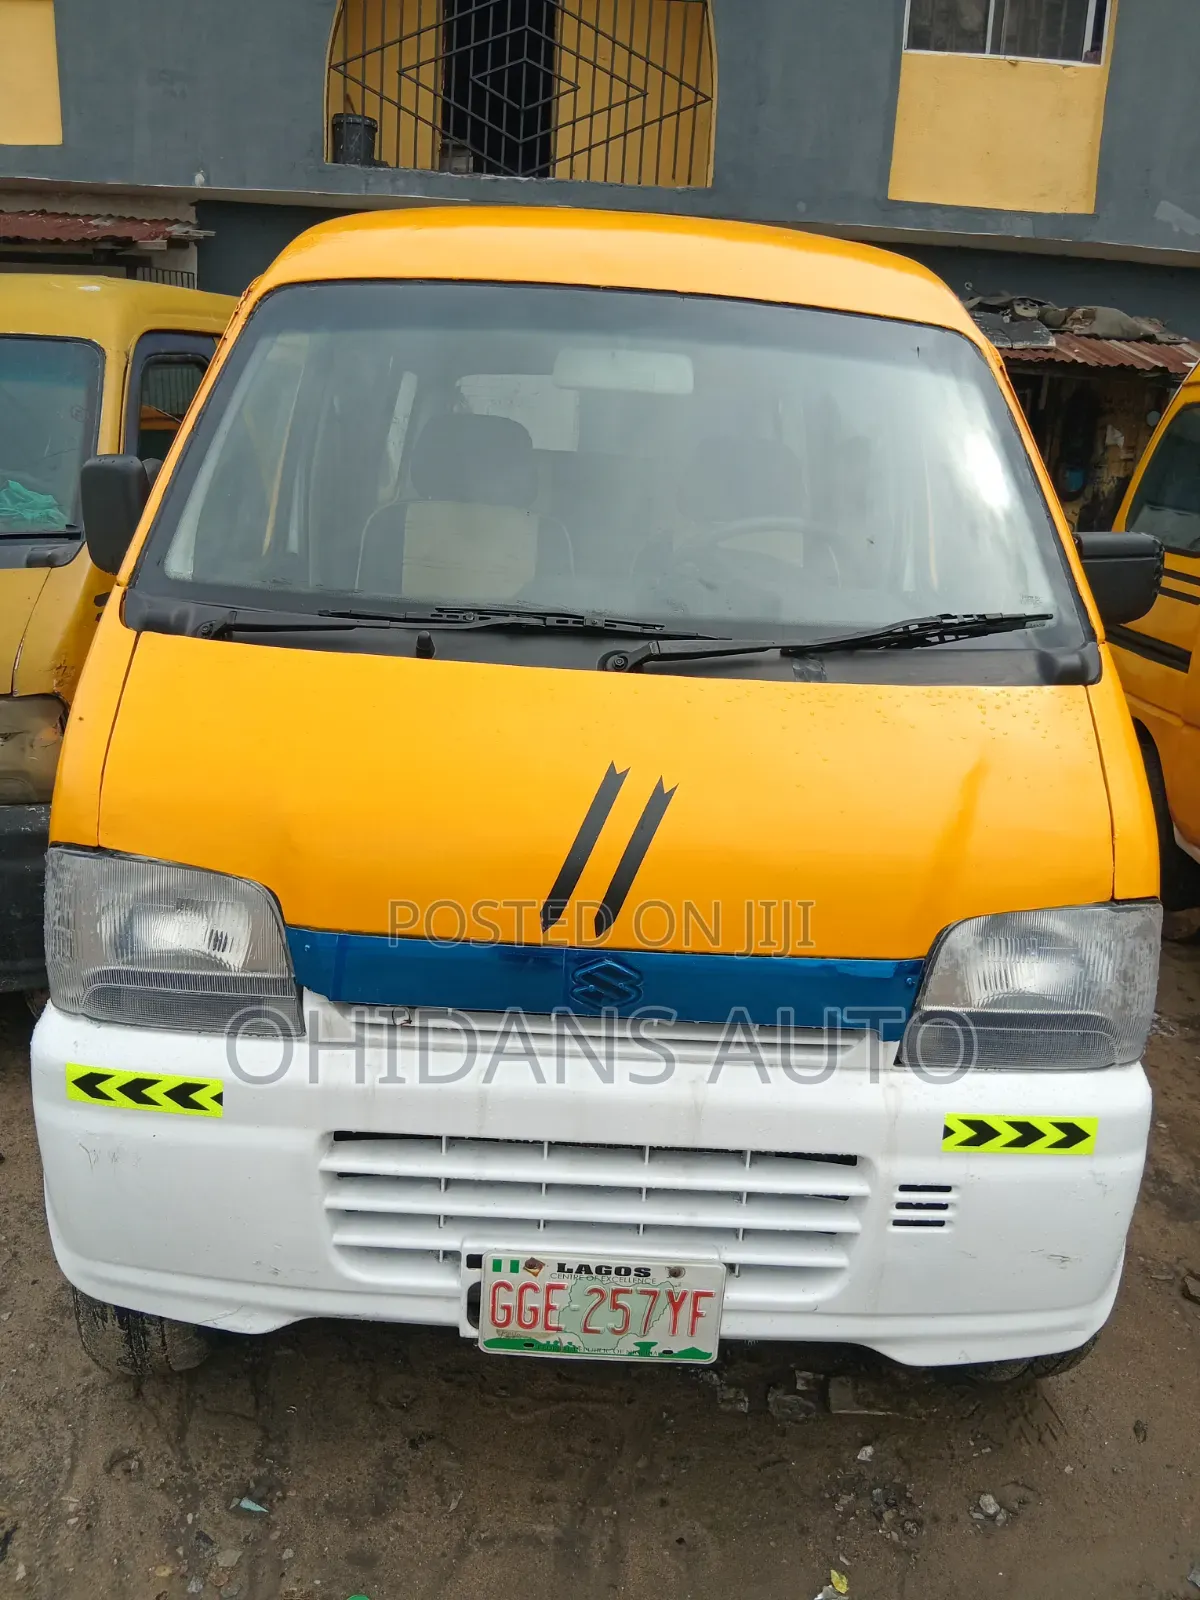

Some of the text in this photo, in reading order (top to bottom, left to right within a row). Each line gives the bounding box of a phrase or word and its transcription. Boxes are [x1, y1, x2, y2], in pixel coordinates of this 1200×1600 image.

[556, 1262, 652, 1278] LAGOS
[550, 1272, 584, 1281] CENTRE
[601, 1275, 657, 1285] EXCELLENCE
